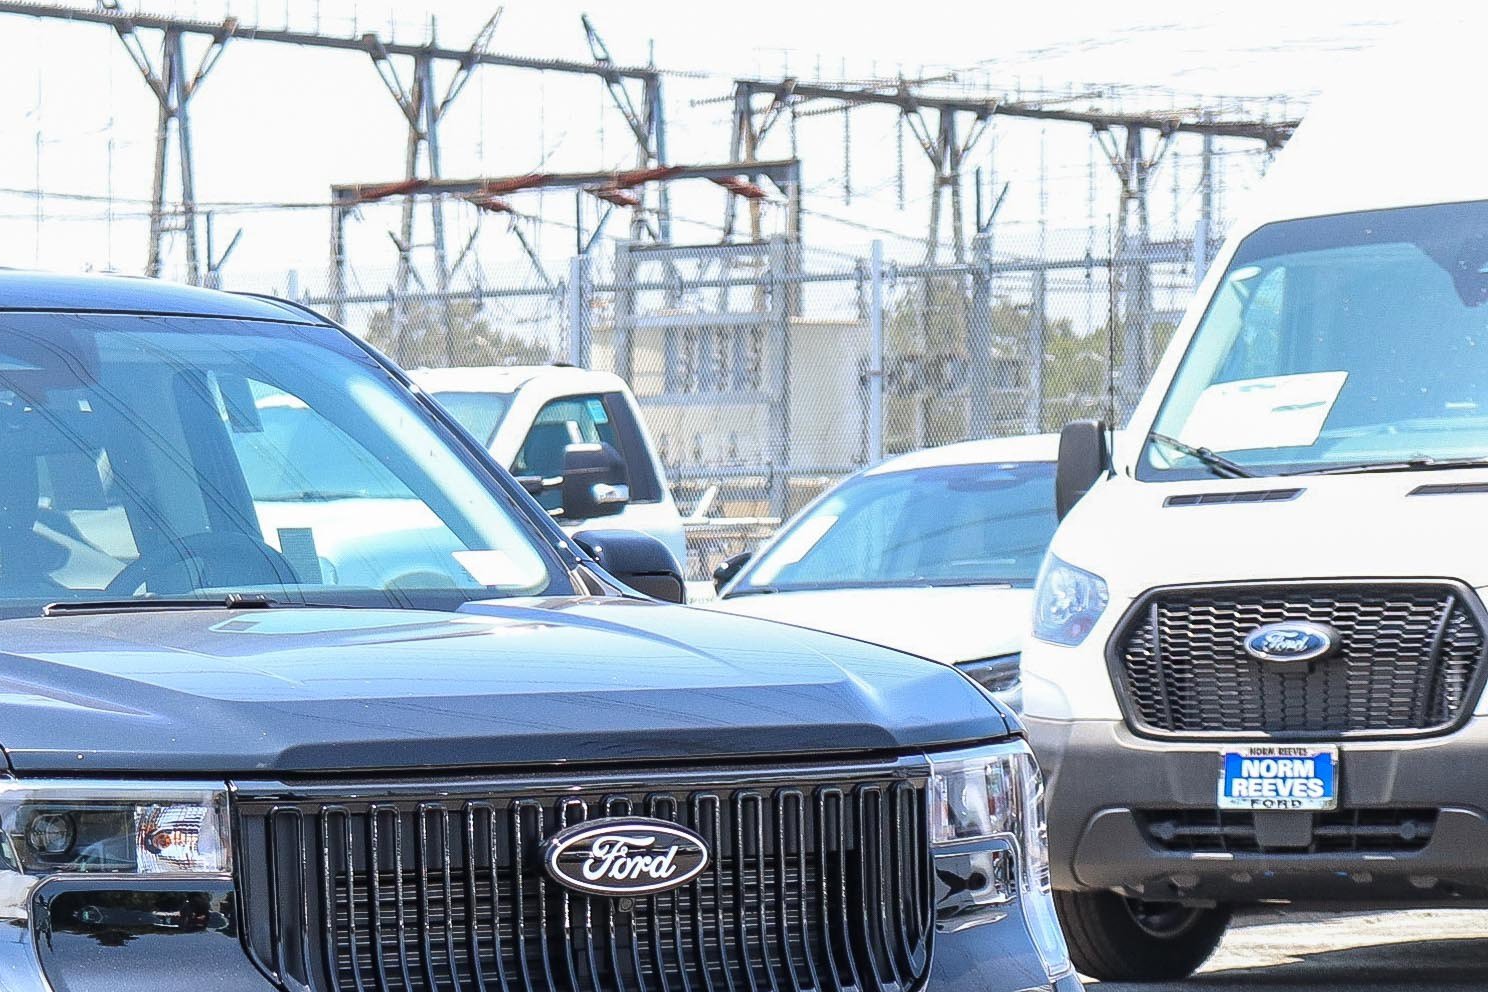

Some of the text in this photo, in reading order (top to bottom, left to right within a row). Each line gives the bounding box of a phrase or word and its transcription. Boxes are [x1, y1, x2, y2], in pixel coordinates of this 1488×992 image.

[1263, 630, 1309, 652] Ford
[1250, 747, 1308, 756] NORM REEVES
[1241, 759, 1315, 778] NORM
[1231, 778, 1325, 798] REEVES
[1250, 799, 1303, 809] FORD
[582, 835, 680, 881] Ford
